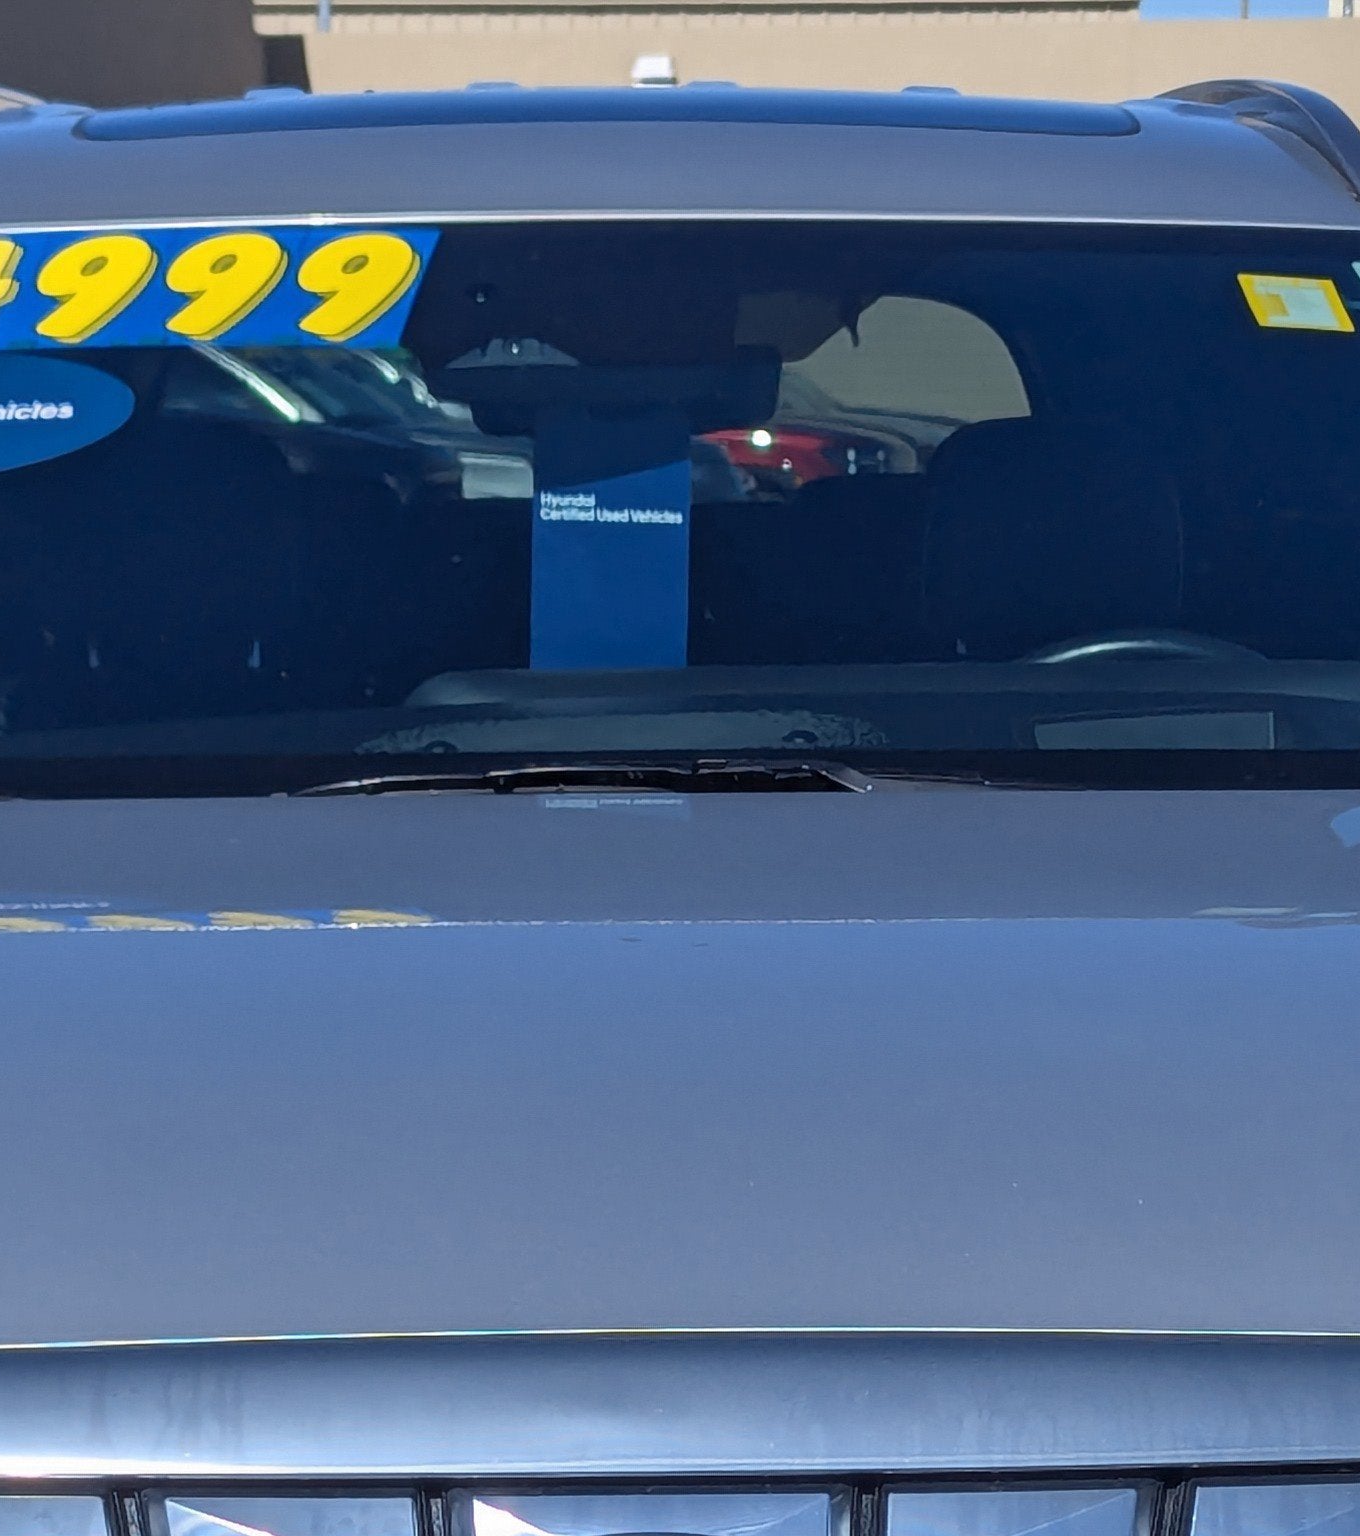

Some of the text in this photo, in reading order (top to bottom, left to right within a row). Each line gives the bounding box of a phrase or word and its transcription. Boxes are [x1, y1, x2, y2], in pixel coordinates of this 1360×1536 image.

[540, 491, 596, 508] Hyundai
[540, 507, 683, 524] Certified Used Vehicles
